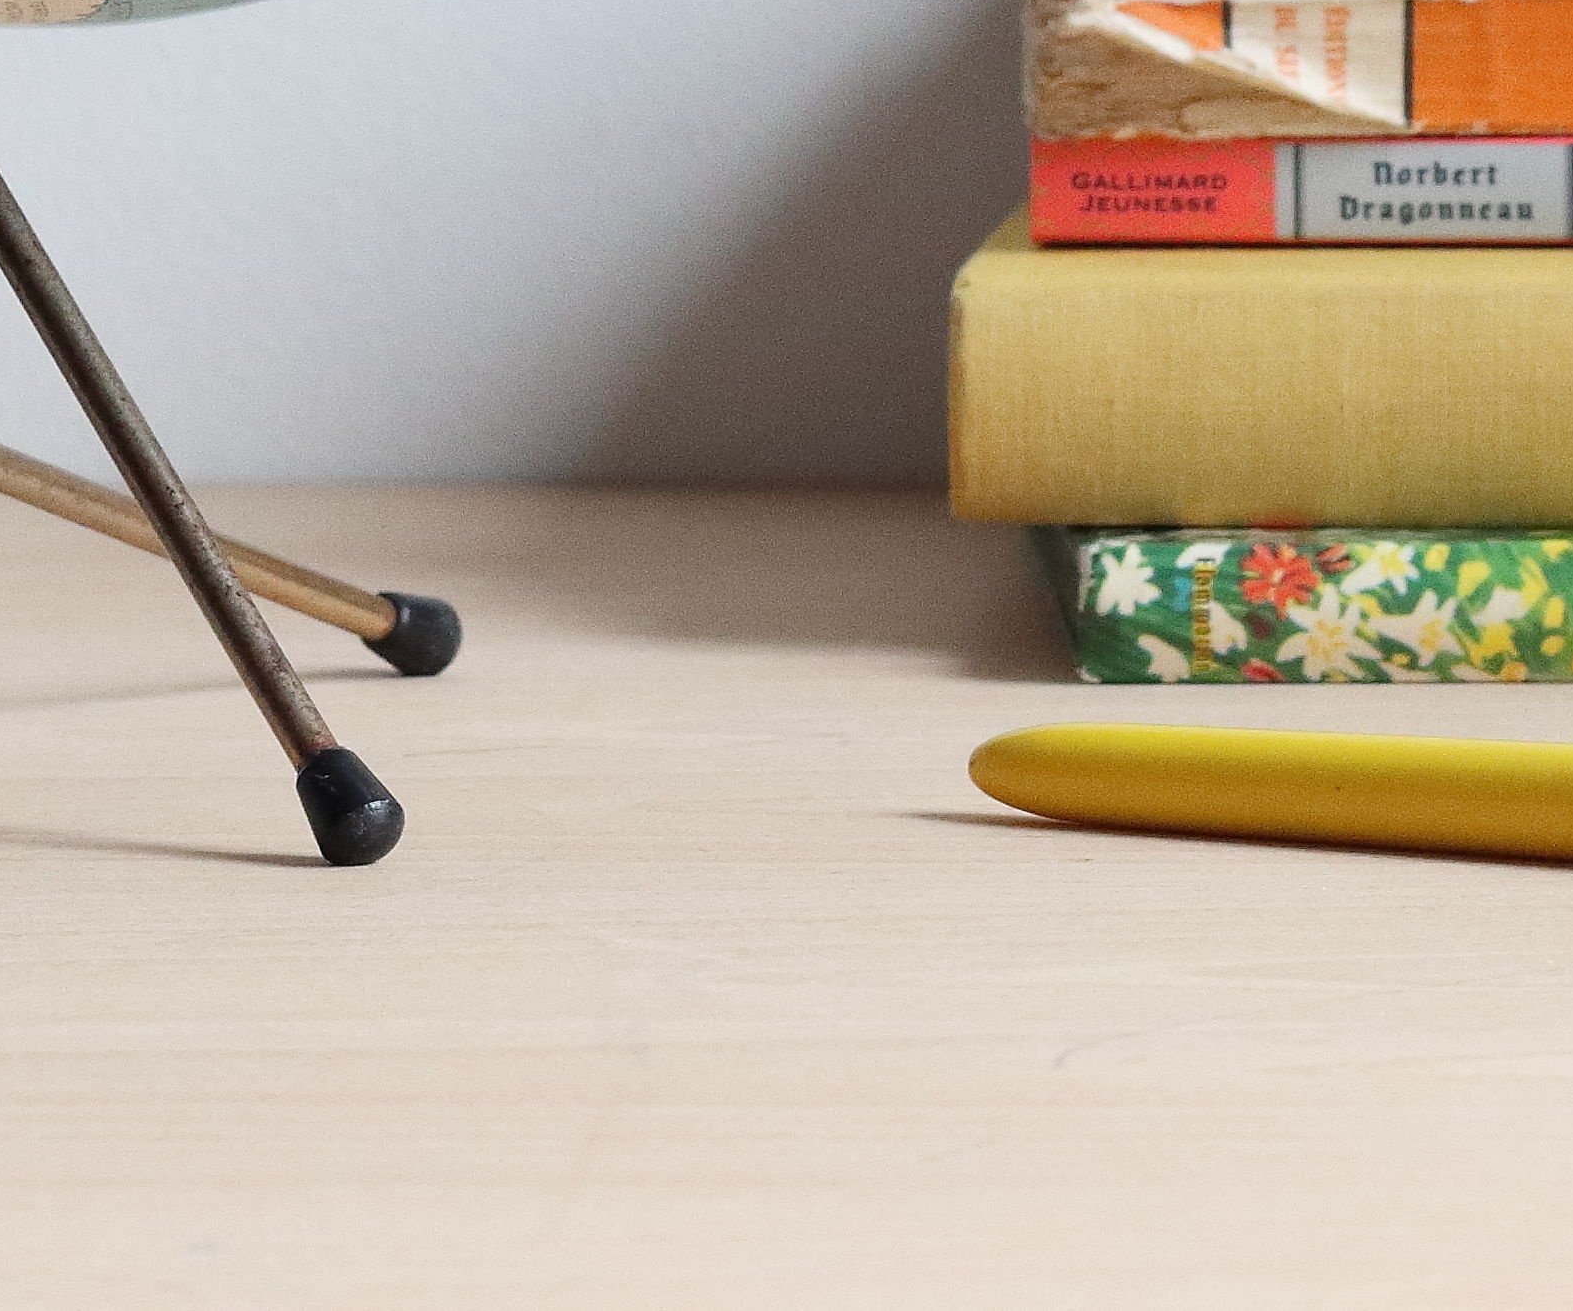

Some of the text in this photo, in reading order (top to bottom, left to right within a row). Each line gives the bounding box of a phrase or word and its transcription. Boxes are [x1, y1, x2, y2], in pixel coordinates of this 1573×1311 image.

[1072, 172, 1228, 191] GALLIMARD
[1373, 161, 1498, 187] Norbert
[1081, 195, 1218, 213] JEUNESSE
[1339, 195, 1535, 221] Dragonneau
